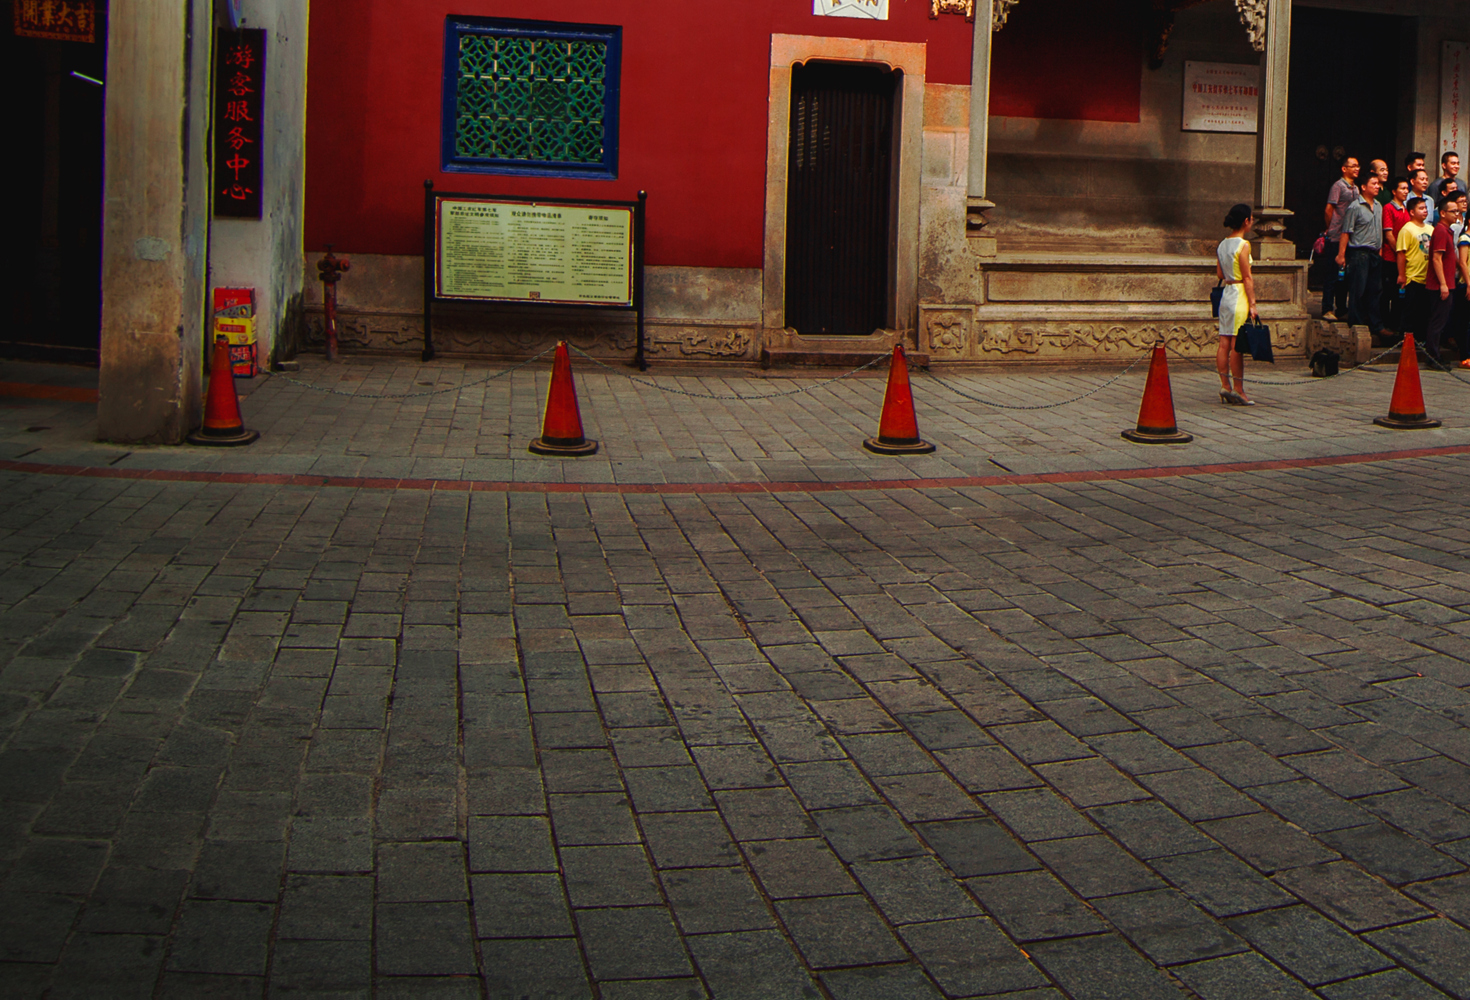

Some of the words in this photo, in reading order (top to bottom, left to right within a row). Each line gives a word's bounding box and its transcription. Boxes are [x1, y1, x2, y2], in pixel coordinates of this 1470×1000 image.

[222, 44, 255, 201] 游客服务中心
